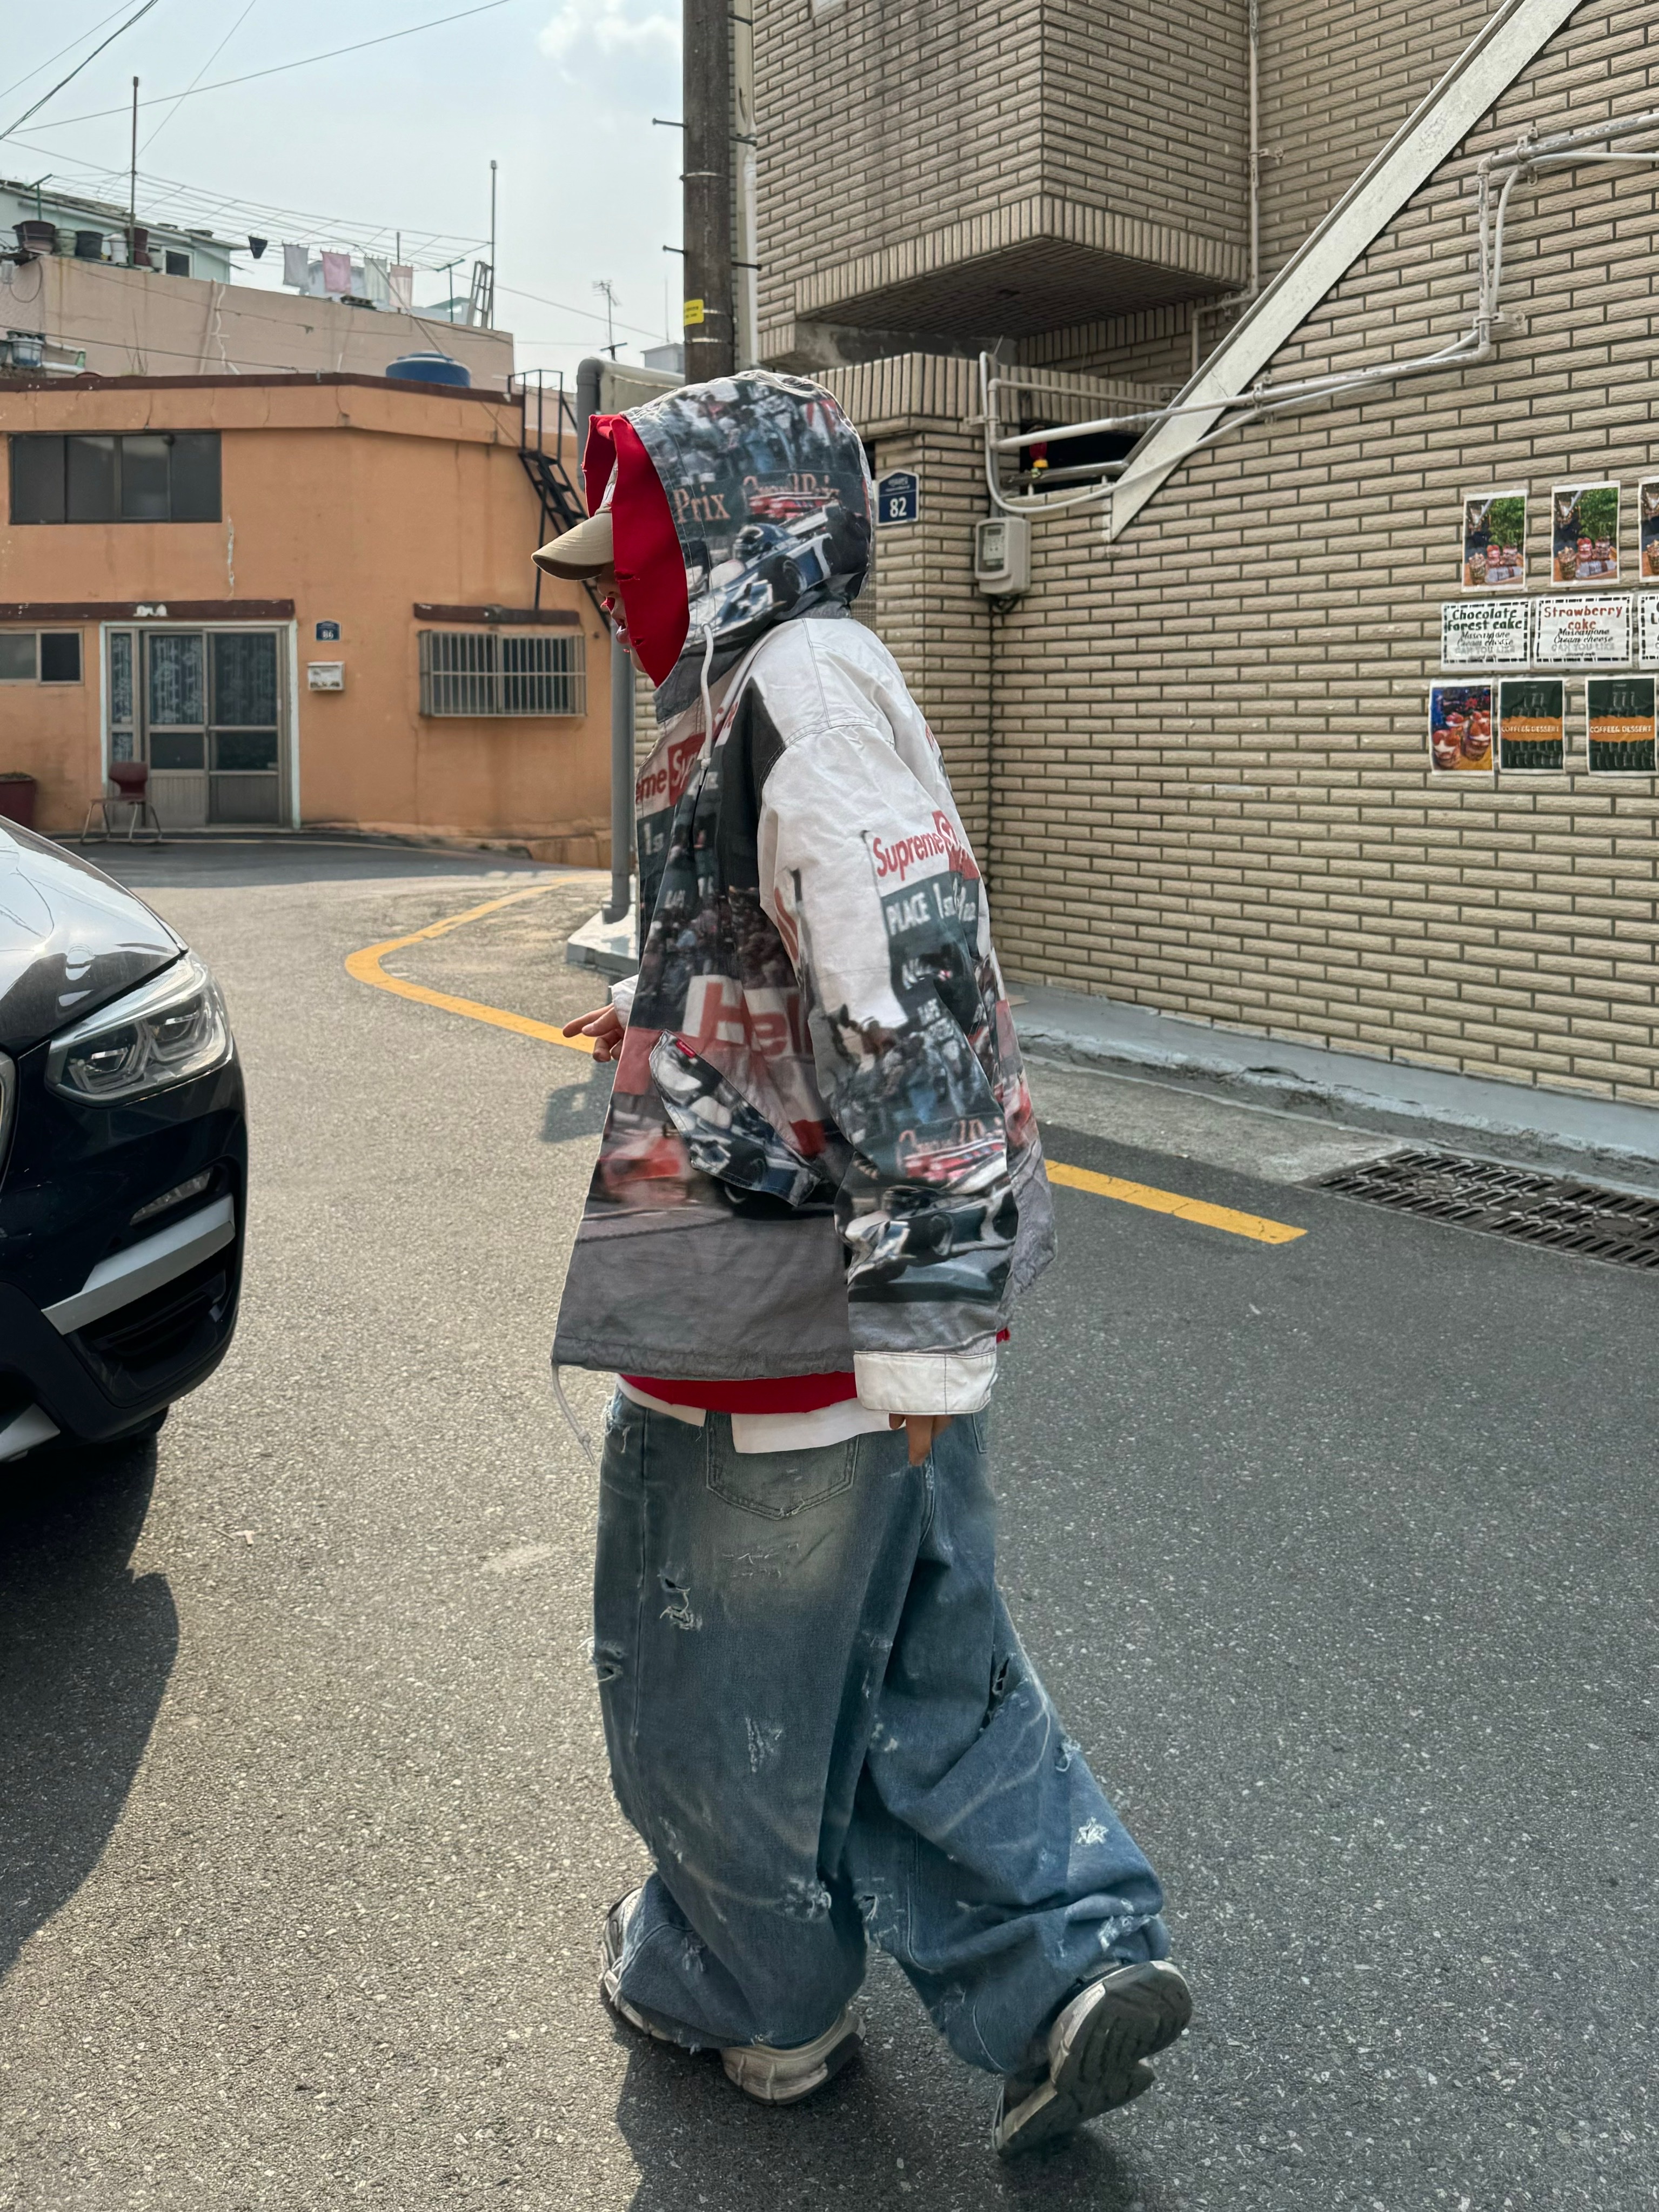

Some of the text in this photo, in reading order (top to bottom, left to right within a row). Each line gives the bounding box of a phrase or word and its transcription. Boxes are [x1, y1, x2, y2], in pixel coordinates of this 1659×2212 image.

[673, 484, 731, 524] Prix
[889, 497, 907, 518] 82
[1452, 608, 1517, 620] Chocolate
[1544, 606, 1622, 618] Strawberry
[1493, 618, 1522, 629] cake
[1568, 618, 1596, 631] cake
[873, 833, 944, 881] Supreme
[698, 982, 813, 1056] Hel
